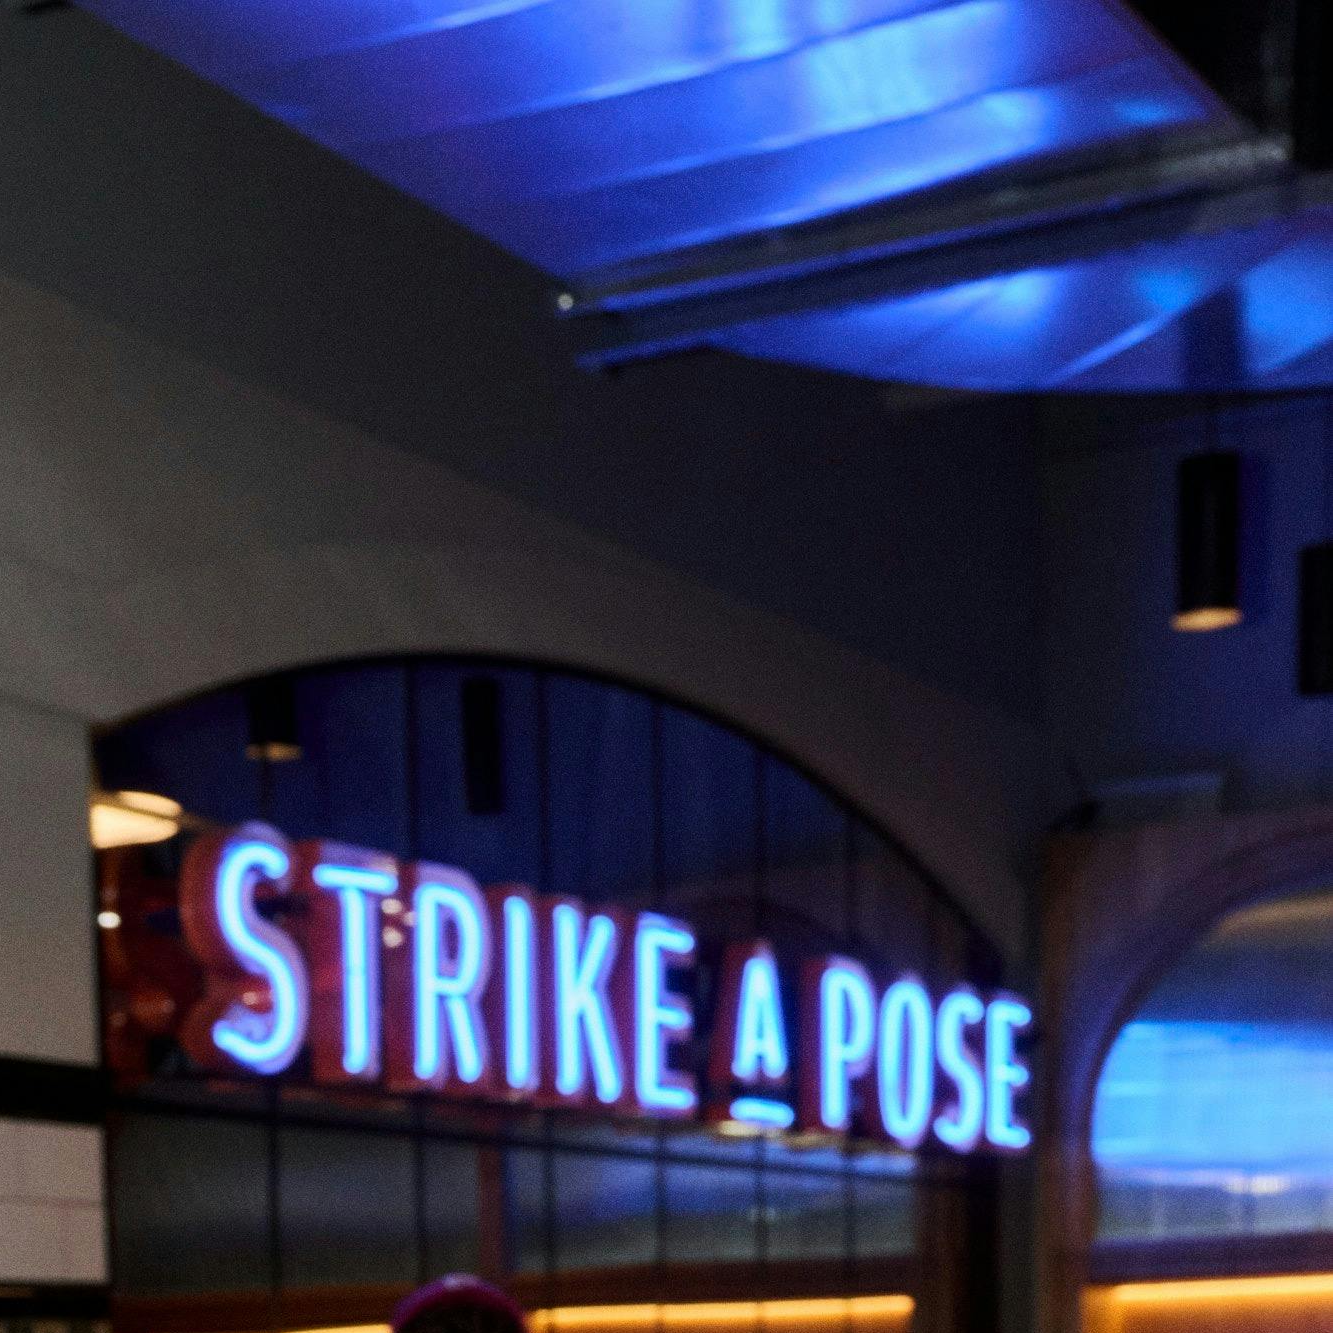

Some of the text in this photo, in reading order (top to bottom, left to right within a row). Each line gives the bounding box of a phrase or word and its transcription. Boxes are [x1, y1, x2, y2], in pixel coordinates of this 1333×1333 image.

[206, 832, 1034, 1152] STRIKE A POSE
